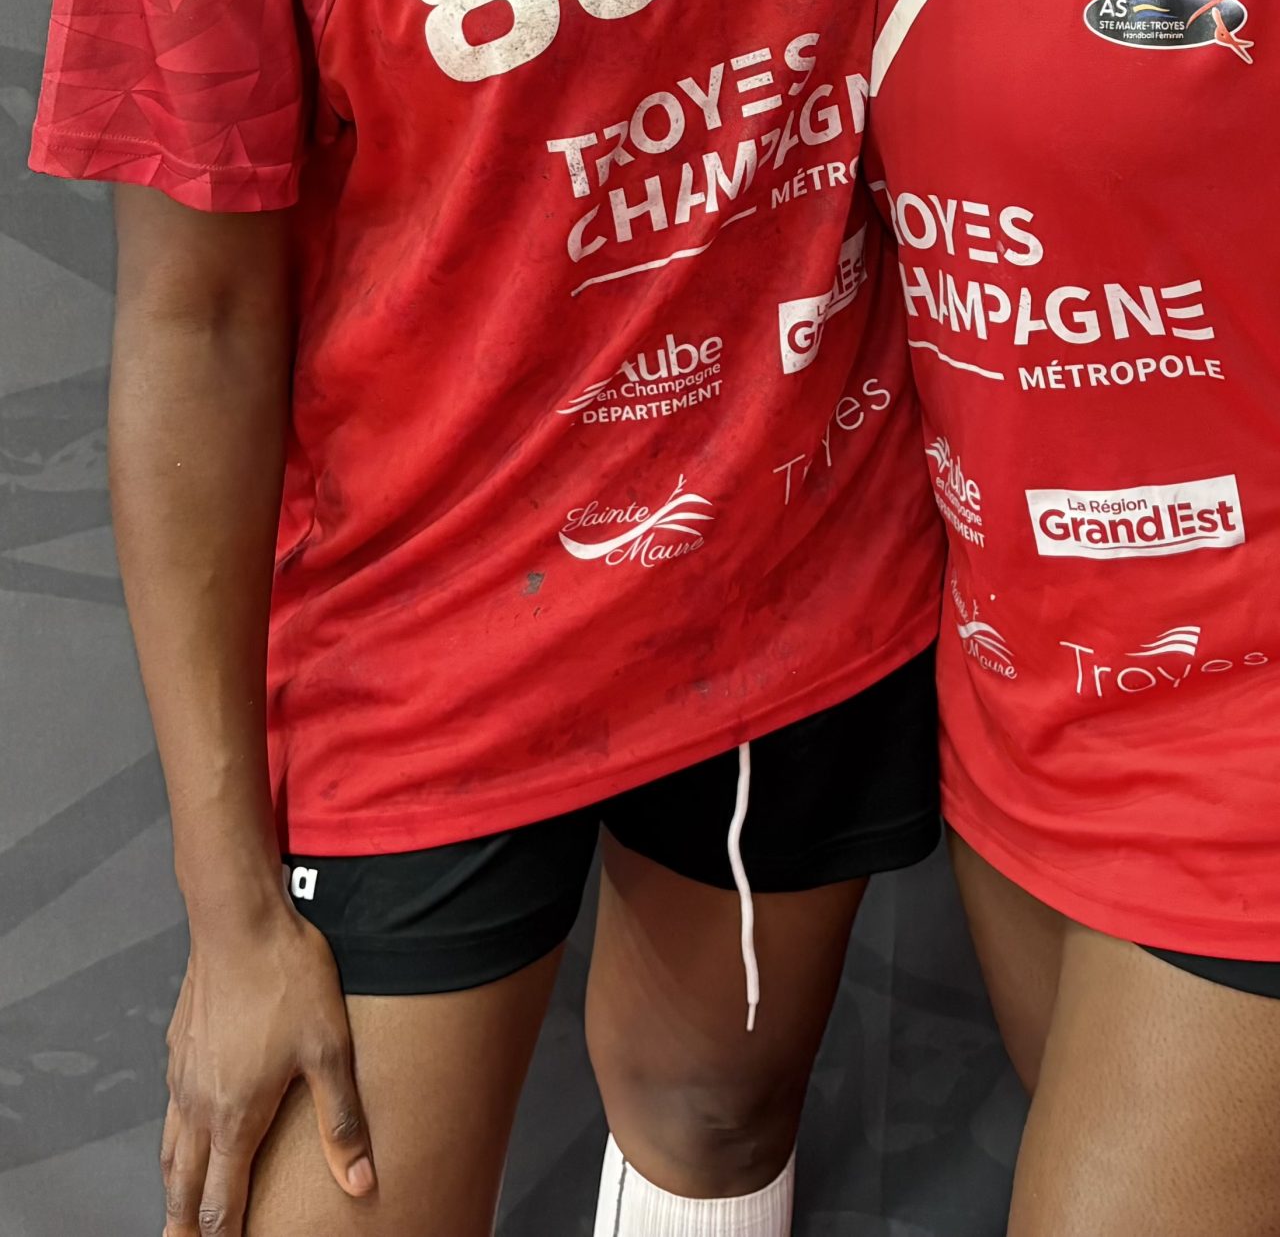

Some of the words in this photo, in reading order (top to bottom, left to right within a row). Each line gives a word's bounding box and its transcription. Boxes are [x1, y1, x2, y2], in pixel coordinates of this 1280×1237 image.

[1099, 20, 1115, 30] STE
[1123, 31, 1155, 40] Handball
[547, 33, 820, 198] TROYES
[567, 73, 869, 263] CHAMPAGN
[899, 261, 1215, 345] HAMPAGNE
[597, 387, 618, 402] en
[620, 363, 721, 398] Champagne
[1018, 353, 1225, 391] MÉTROPOLE
[773, 378, 891, 505] Tyes
[562, 500, 650, 532] Sainte
[1067, 498, 1086, 512] La
[1090, 498, 1148, 515] Région
[605, 532, 704, 568] Maure
